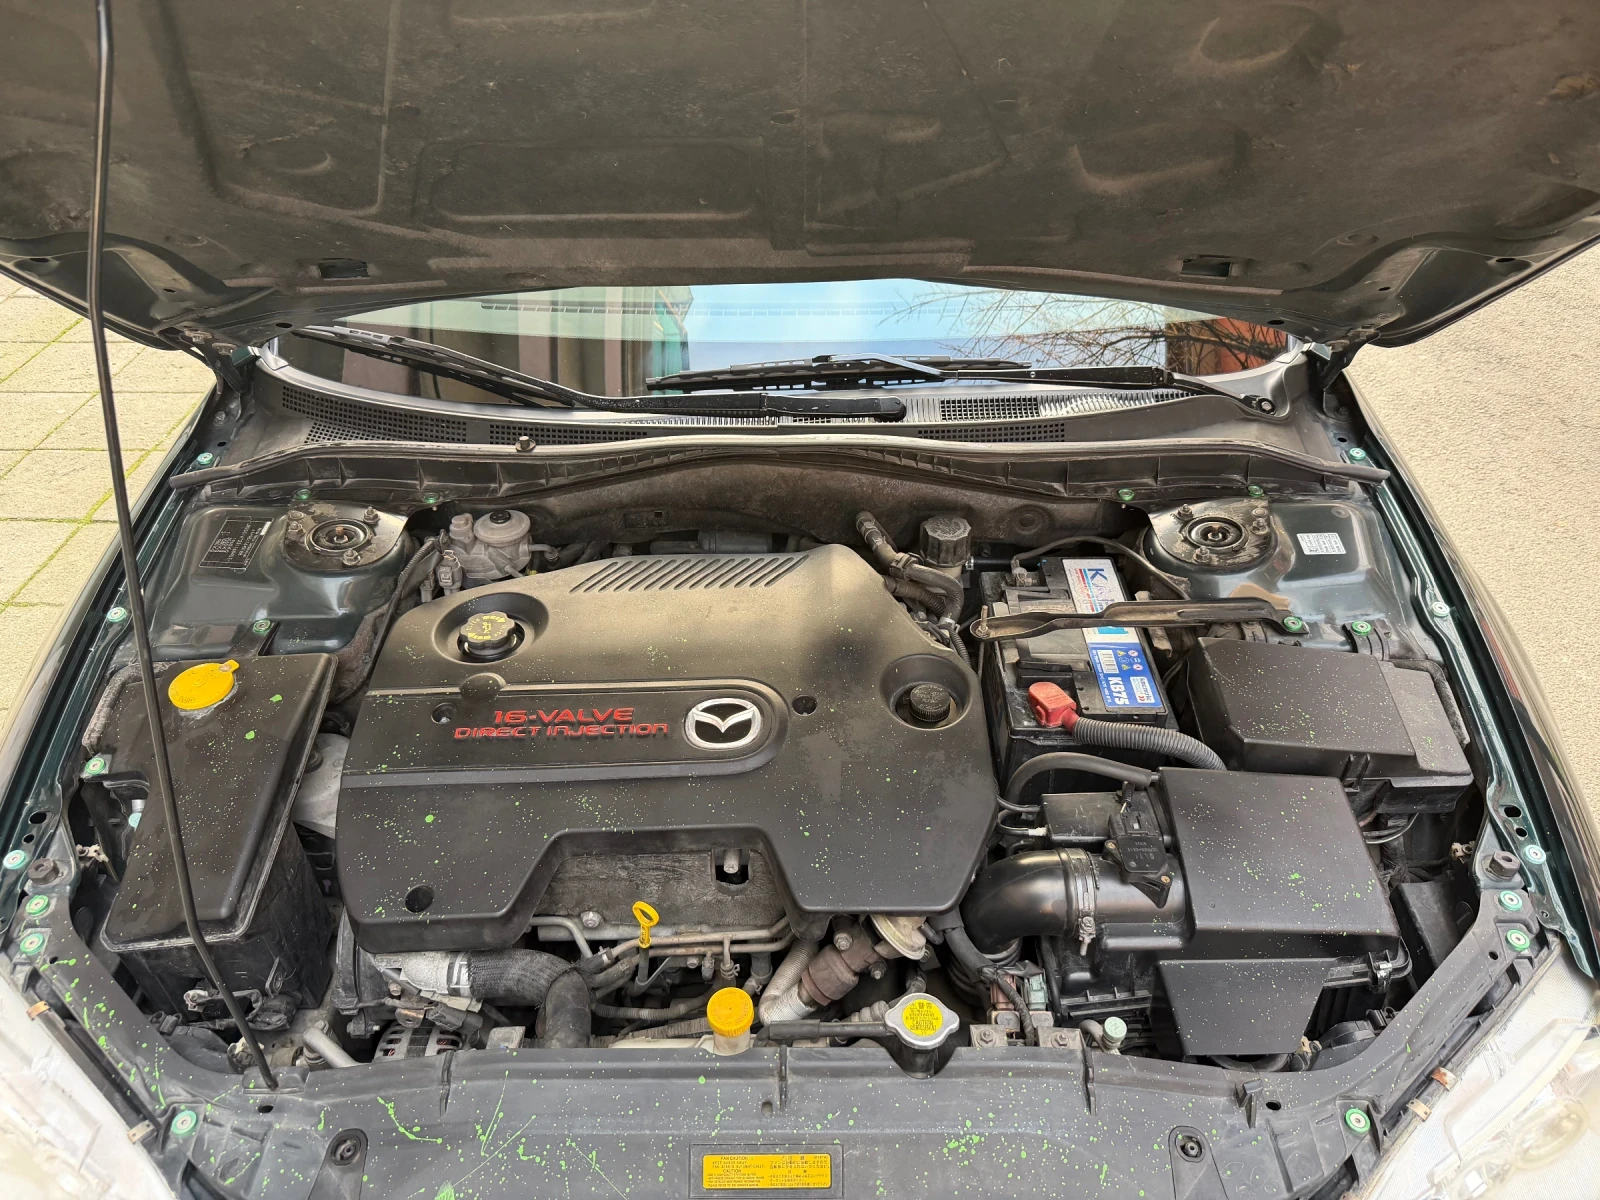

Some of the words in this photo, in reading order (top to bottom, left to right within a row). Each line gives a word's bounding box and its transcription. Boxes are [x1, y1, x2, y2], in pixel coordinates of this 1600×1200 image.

[1107, 676, 1130, 705] KB75
[493, 707, 634, 725] 16-VALVE
[453, 725, 540, 740] DIRECT
[547, 722, 668, 736] INJECTION
